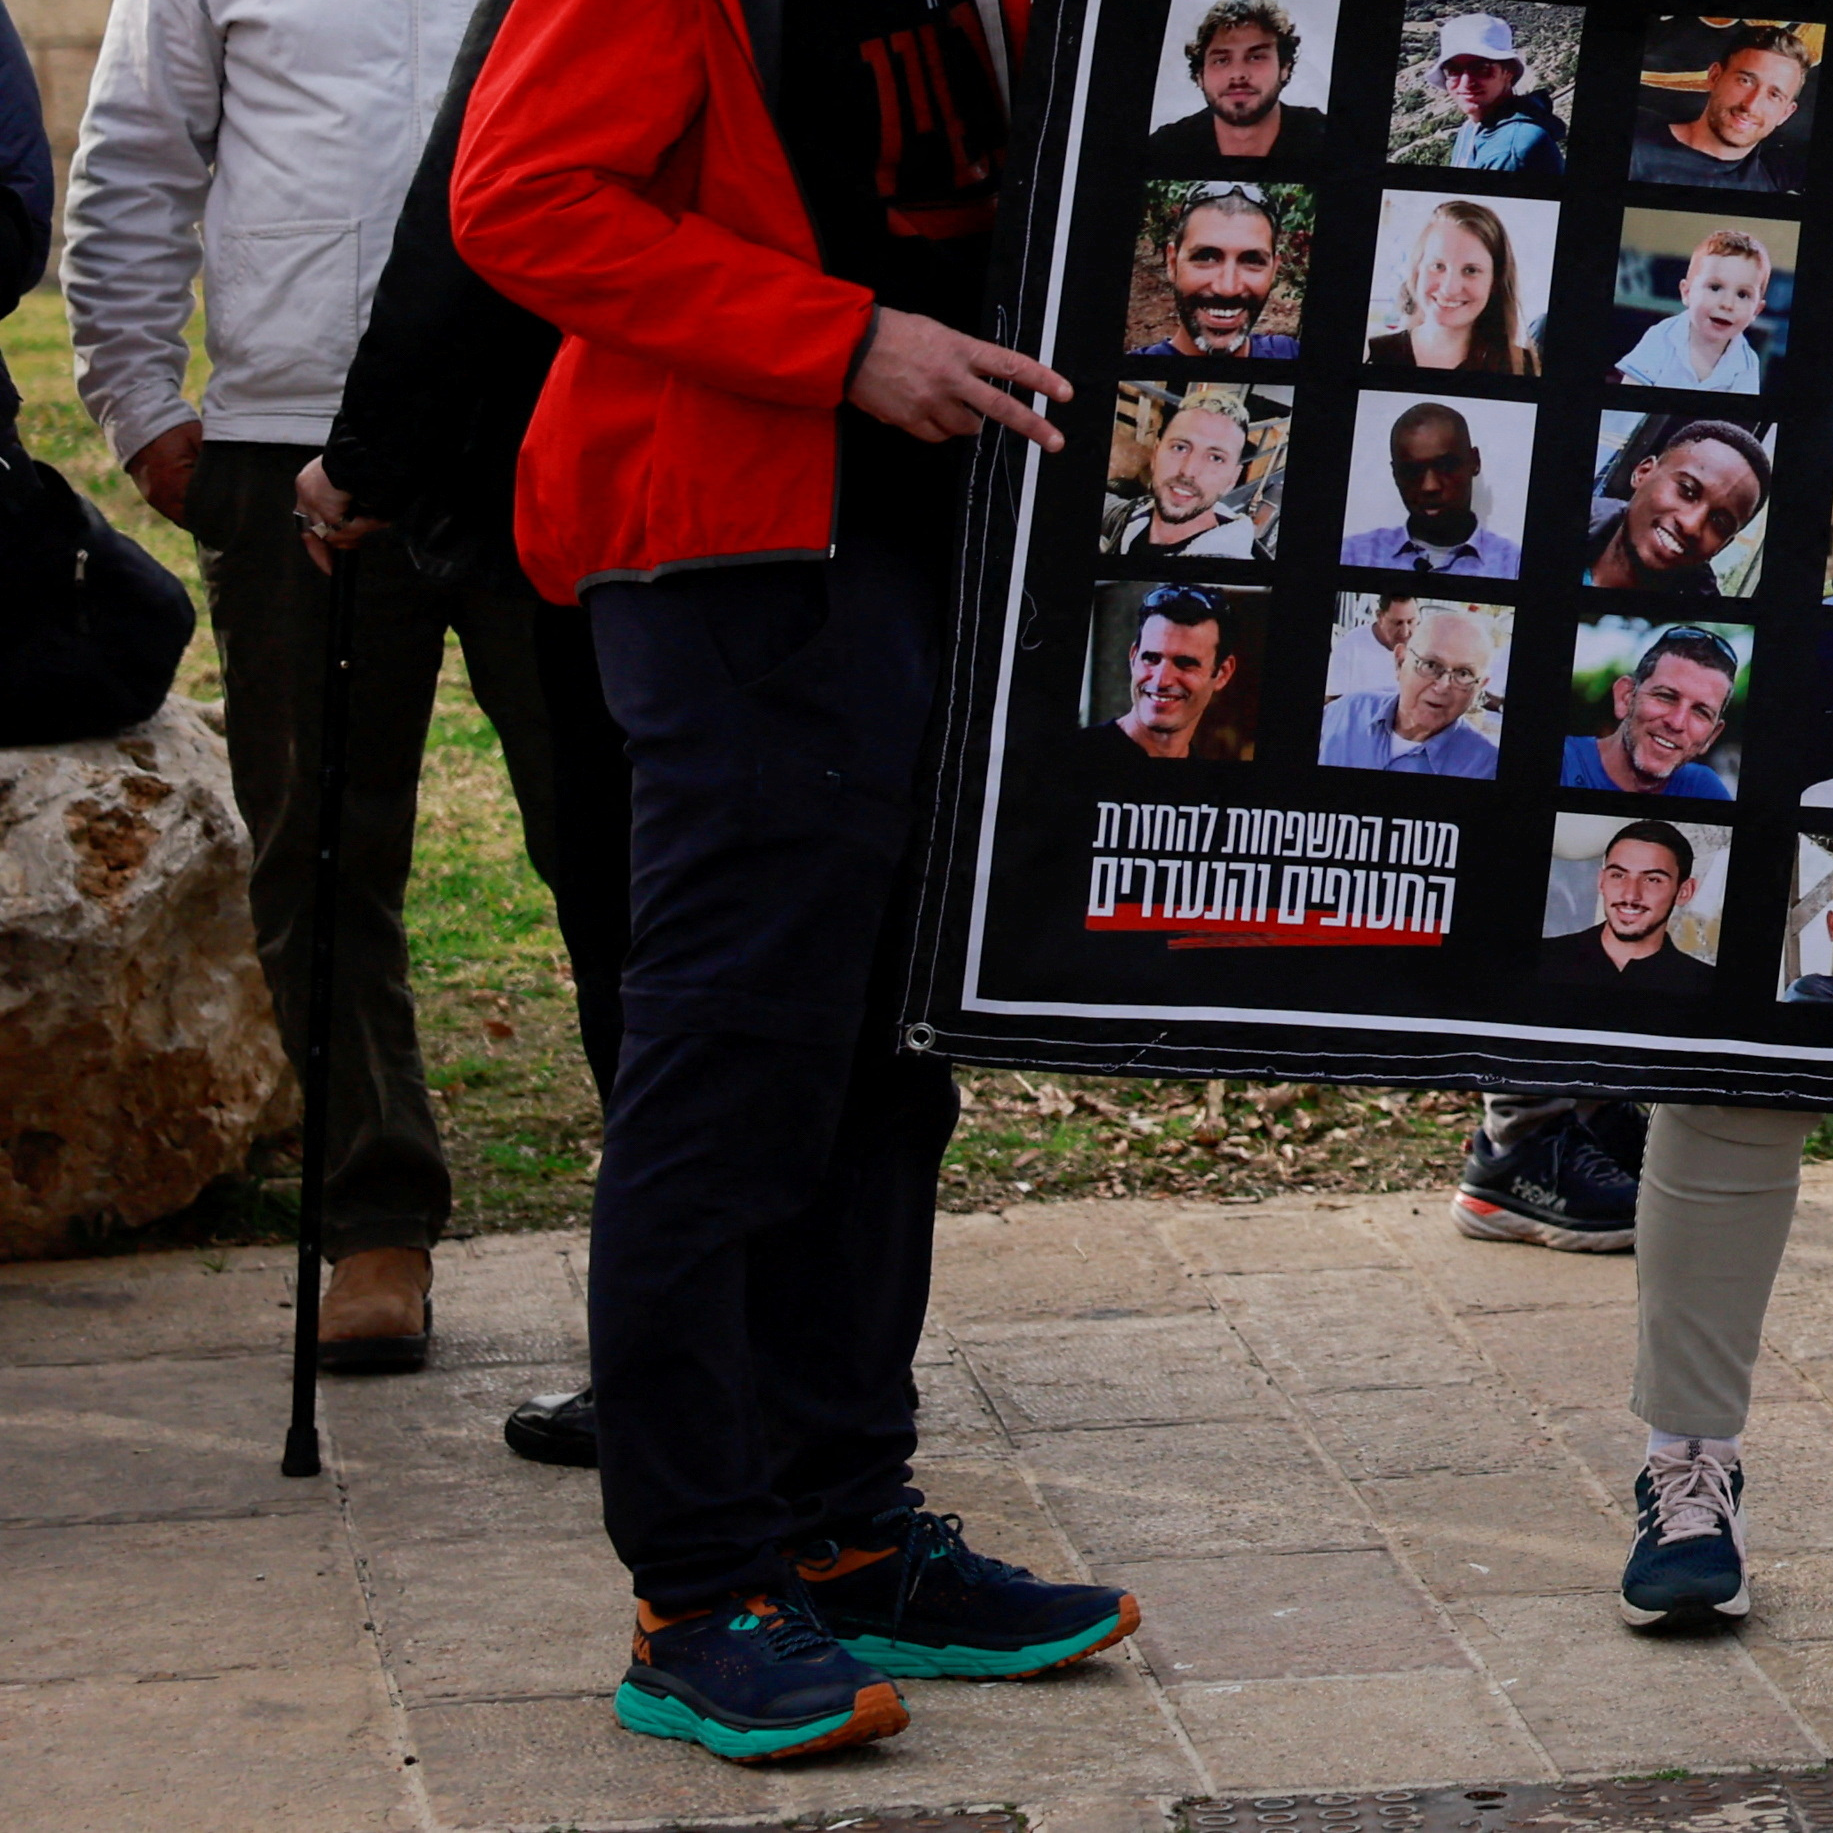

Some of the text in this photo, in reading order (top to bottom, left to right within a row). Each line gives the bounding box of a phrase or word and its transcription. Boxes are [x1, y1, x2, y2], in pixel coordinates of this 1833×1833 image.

[1092, 801, 1460, 870] מטה המשפחות להחזרת
[1087, 856, 1456, 934] החטופים והנעדרים
